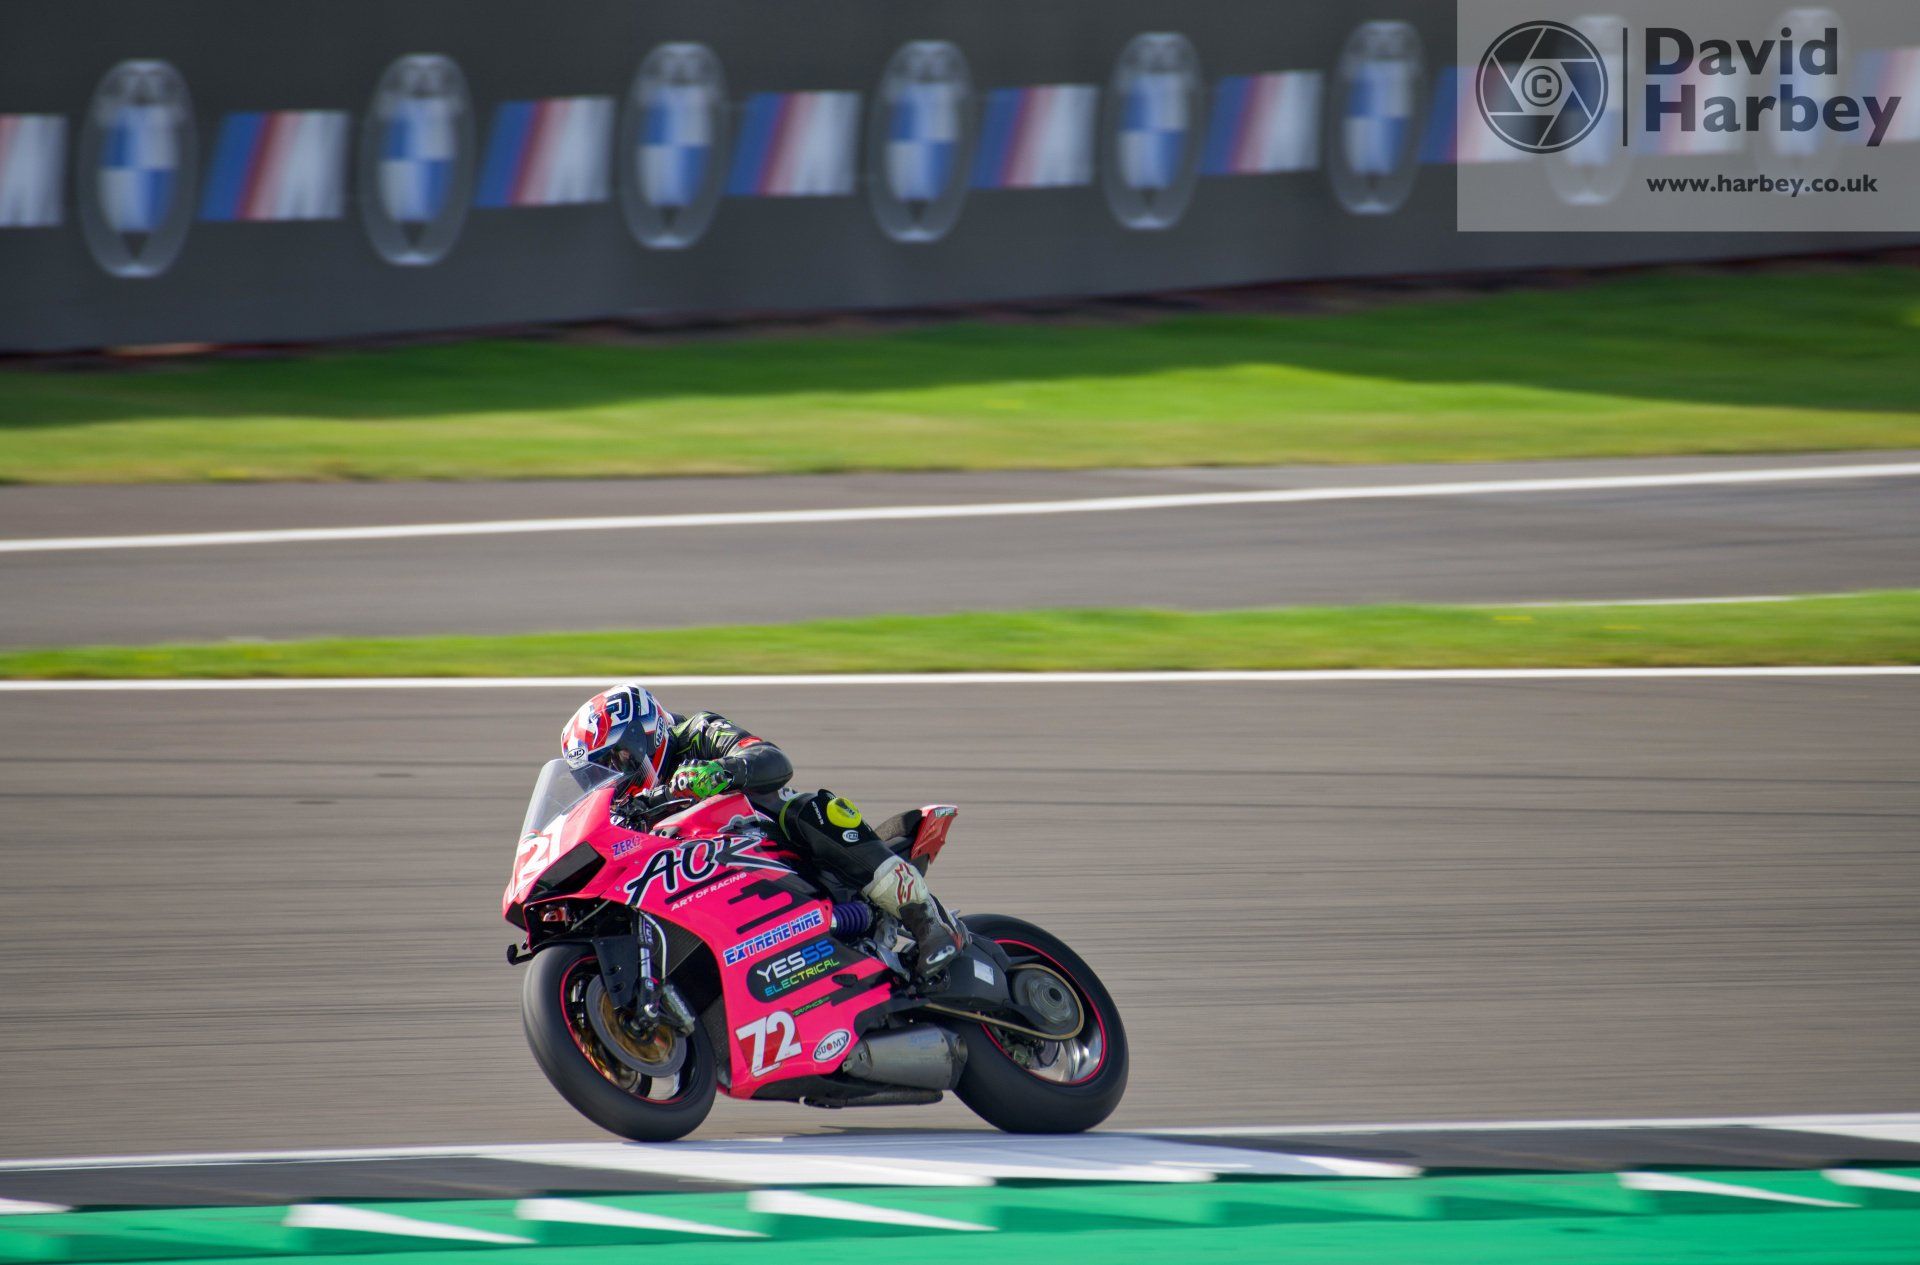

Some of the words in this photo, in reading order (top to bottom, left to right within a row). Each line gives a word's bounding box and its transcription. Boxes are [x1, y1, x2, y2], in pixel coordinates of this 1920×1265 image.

[624, 835, 797, 907] AOR
[671, 894, 694, 911] ART
[695, 888, 709, 899] OF
[710, 872, 747, 892] RACING
[723, 922, 792, 967] EXTREME
[790, 908, 824, 937] HIRE
[757, 938, 836, 983] YESSS
[764, 958, 840, 997] ELECTRICAL
[735, 1010, 802, 1076] 72
